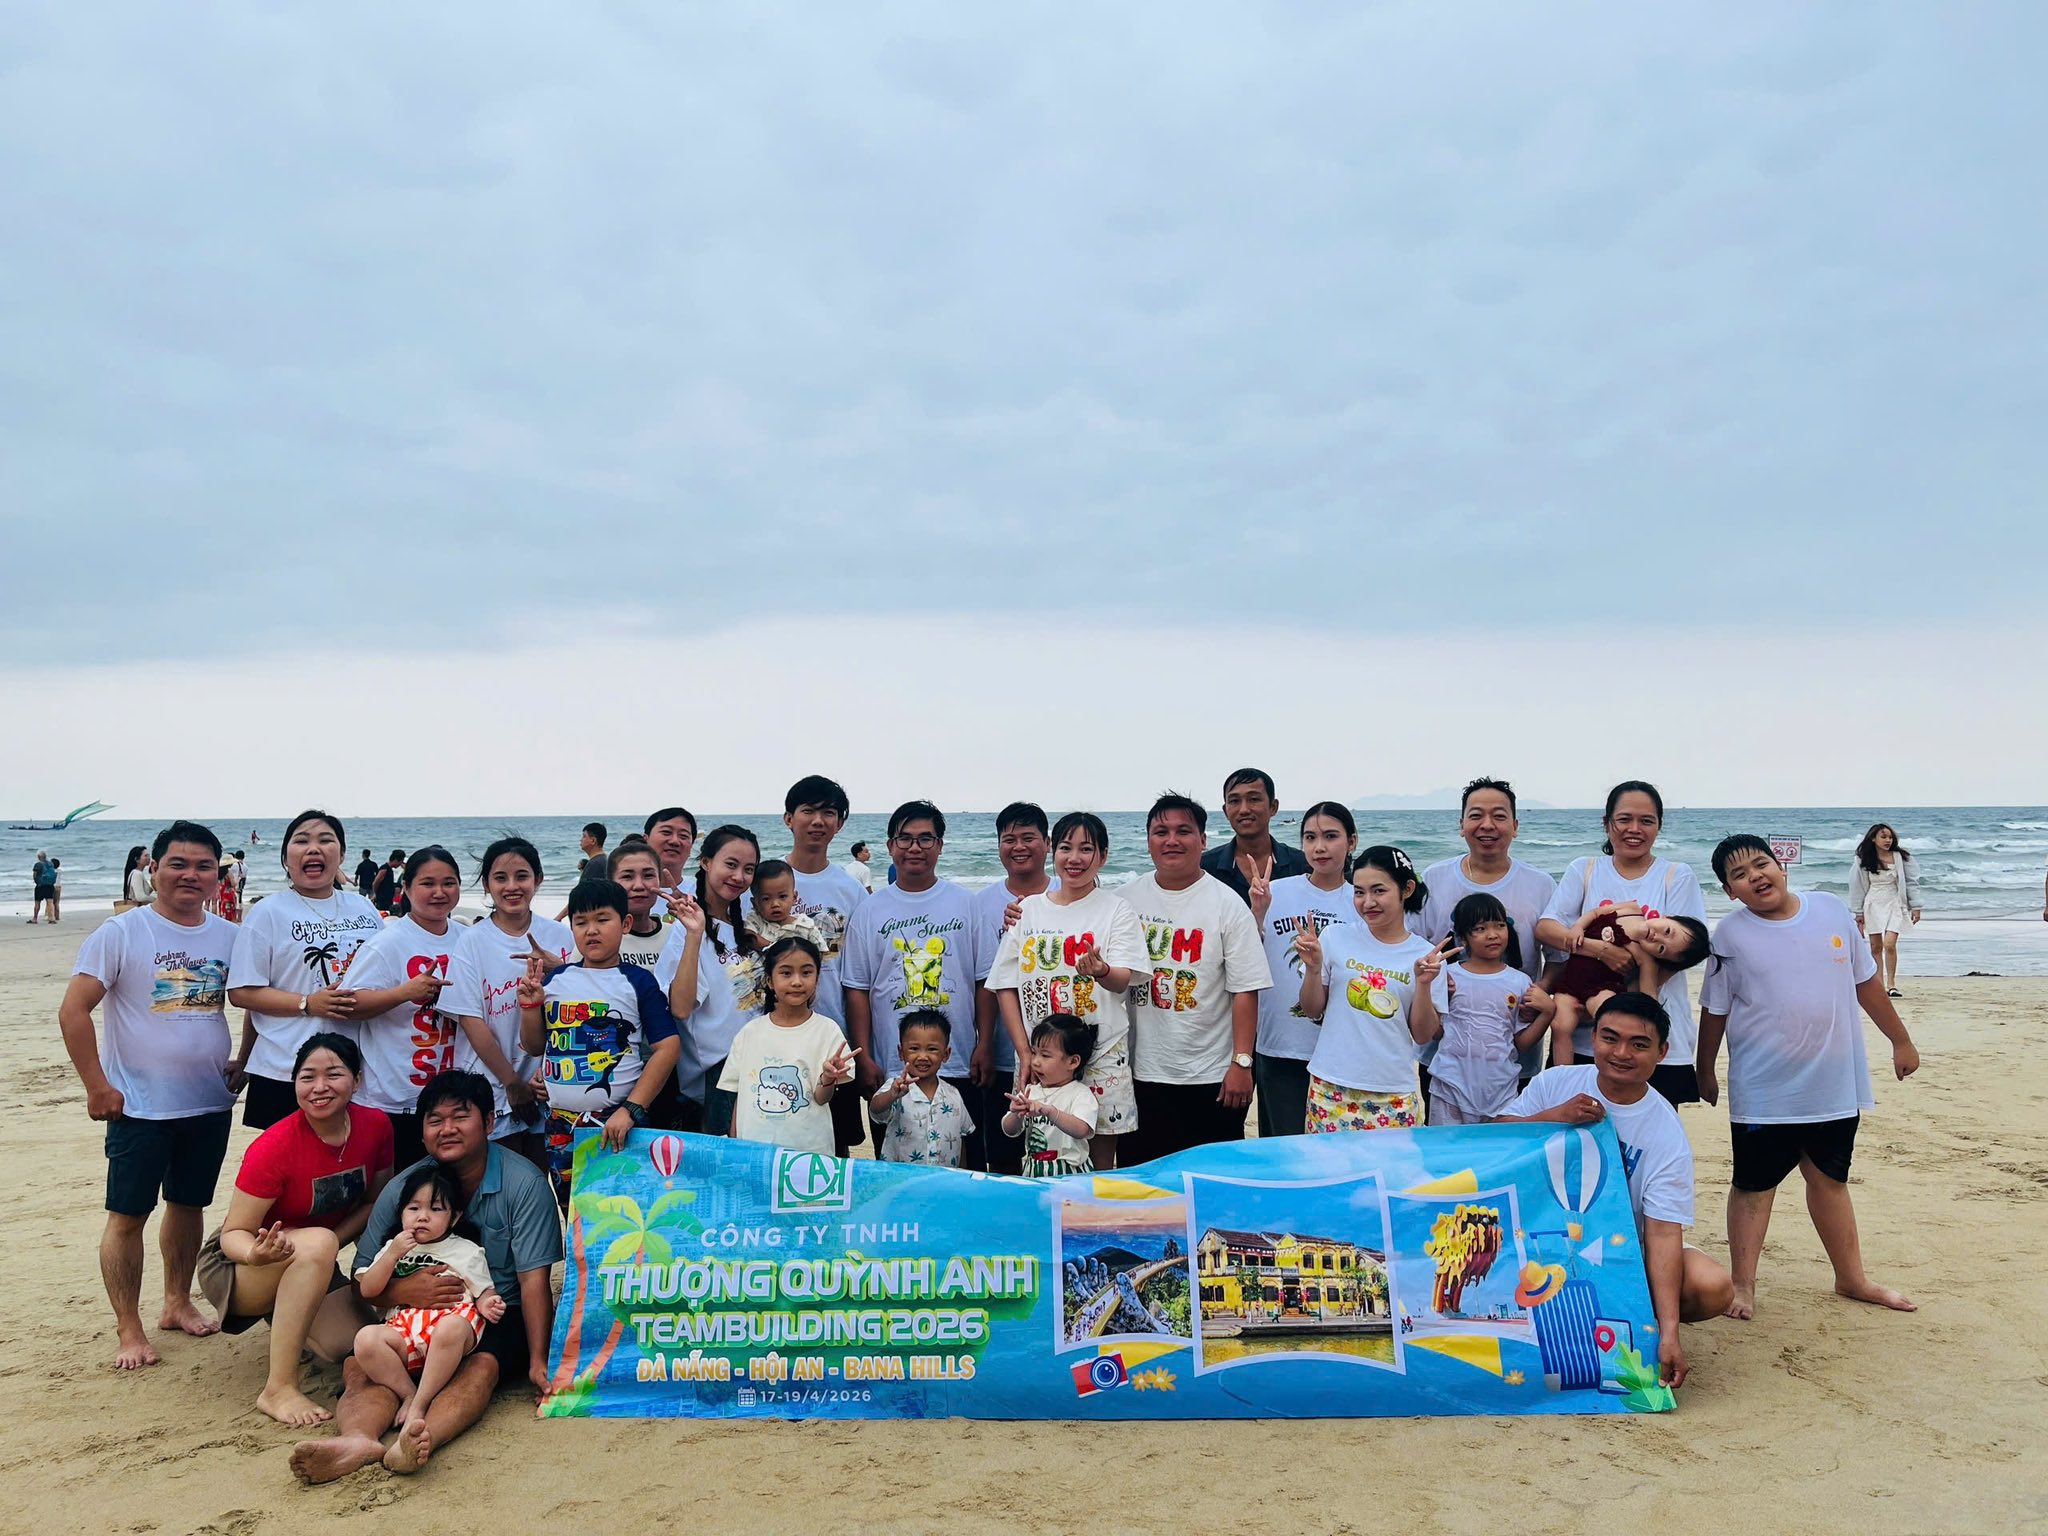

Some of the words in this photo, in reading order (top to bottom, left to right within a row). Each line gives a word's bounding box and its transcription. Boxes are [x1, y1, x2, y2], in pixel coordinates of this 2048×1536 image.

[292, 920, 328, 944] Enjoy
[878, 914, 929, 939] Gimme
[917, 917, 964, 939] Studio
[1020, 931, 1095, 973] SUM
[1140, 923, 1204, 964] UM
[154, 950, 186, 965] Embrace
[1345, 958, 1411, 985] Coconut
[546, 1001, 609, 1024] JUST
[545, 1056, 595, 1082] DUDE
[700, 1222, 782, 1248] CÔNG
[794, 1225, 828, 1245] TY
[841, 1222, 920, 1245] TNHH
[597, 1257, 775, 1309] THƯỢNG
[780, 1252, 931, 1299] QUỲNH
[938, 1256, 1036, 1298] ANH
[631, 1311, 883, 1345] TEAMBUILDING
[888, 1310, 986, 1343] 2026
[636, 1353, 668, 1382] ĐÀ
[672, 1350, 731, 1382] NẴNG
[749, 1351, 788, 1385] HỘI
[792, 1357, 824, 1382] AN
[843, 1356, 905, 1381] BANA
[909, 1354, 976, 1381] HILLS
[759, 1389, 872, 1404] 17-19/4/2026
